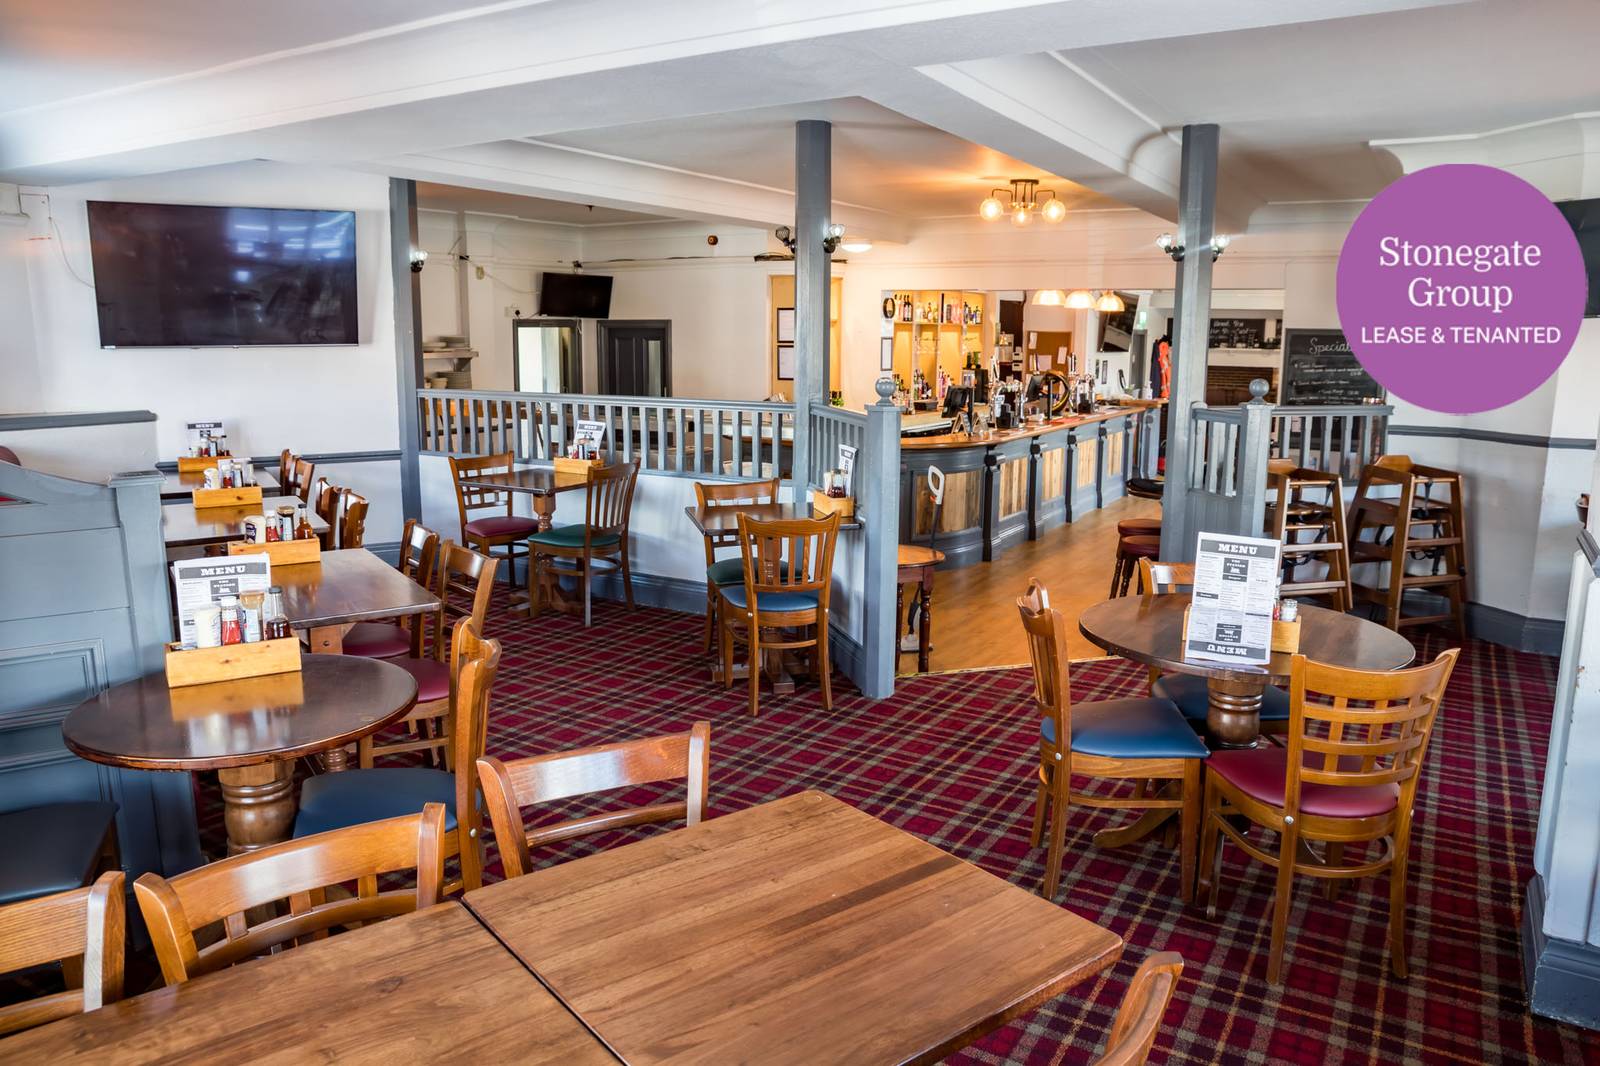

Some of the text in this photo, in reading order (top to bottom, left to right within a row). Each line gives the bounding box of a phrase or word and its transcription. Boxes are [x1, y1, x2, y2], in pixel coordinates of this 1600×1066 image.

[1218, 543, 1258, 555] MENU
[200, 565, 246, 576] MENU
[1207, 643, 1247, 656] MENU
